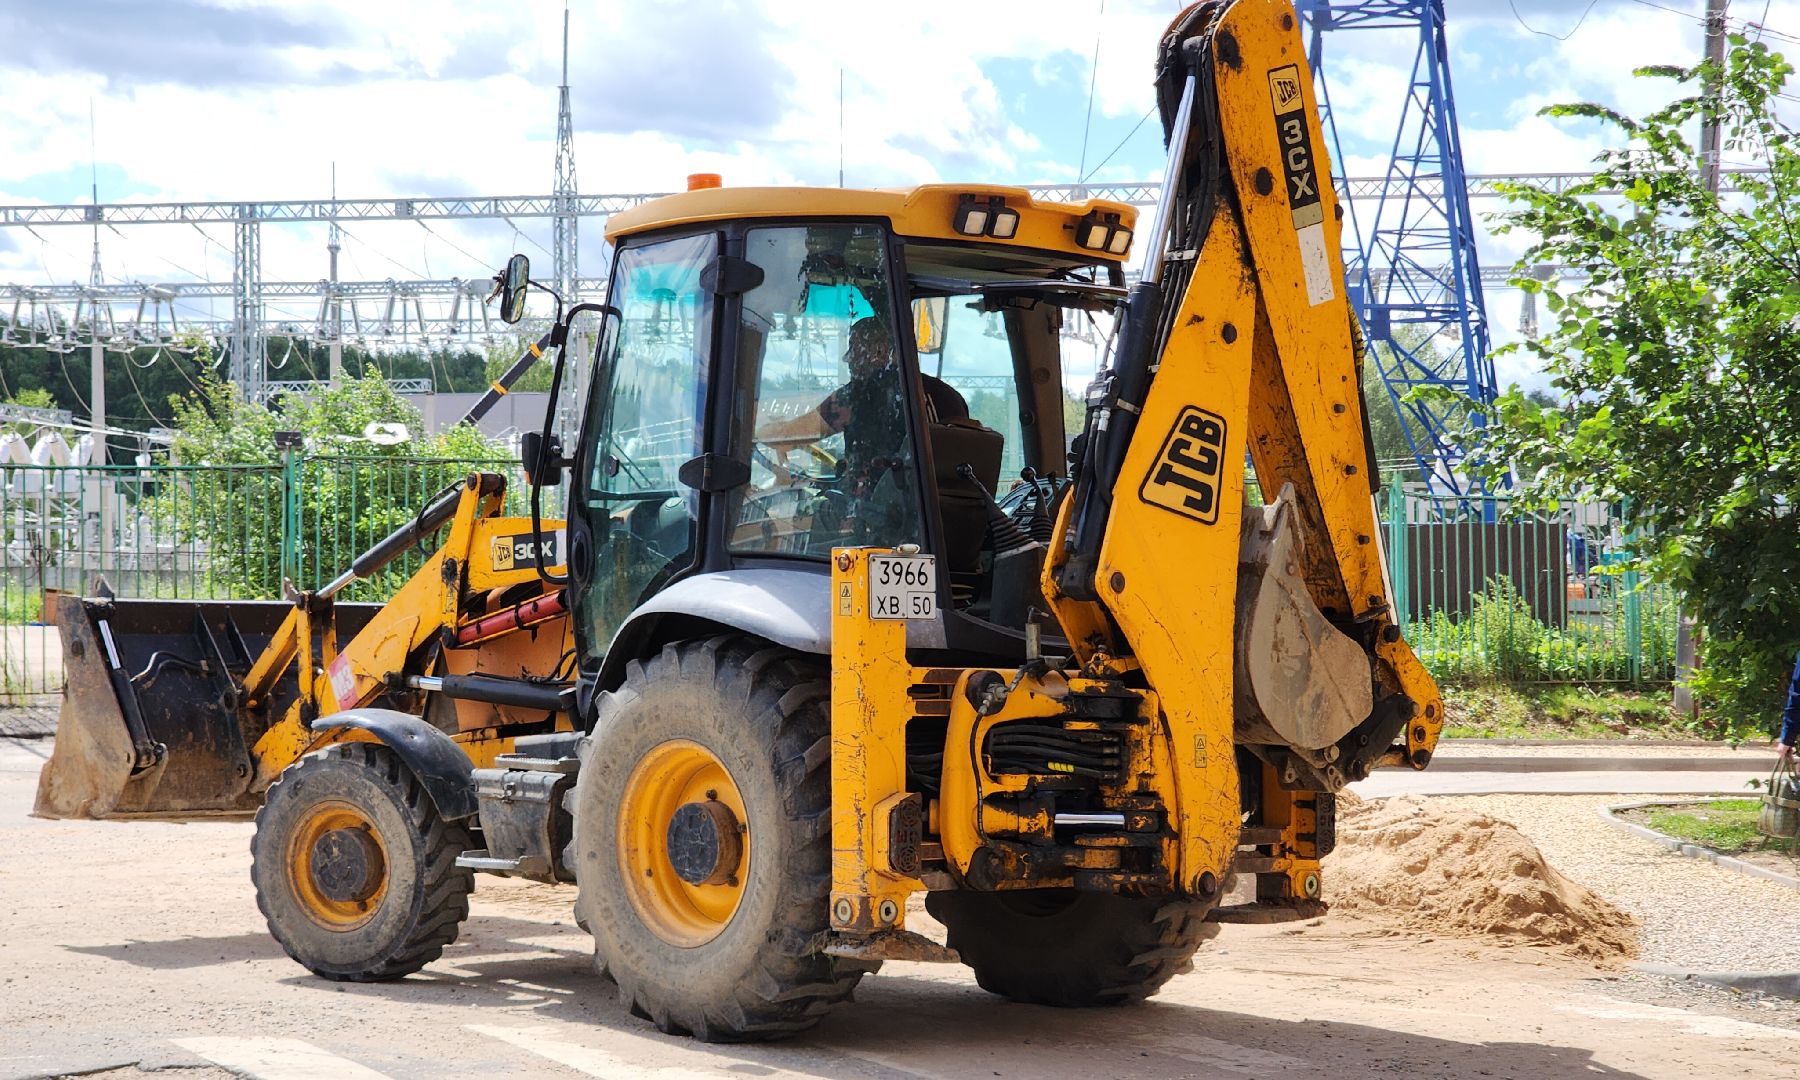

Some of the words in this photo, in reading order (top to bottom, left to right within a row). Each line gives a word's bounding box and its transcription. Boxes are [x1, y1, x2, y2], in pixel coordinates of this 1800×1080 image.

[1277, 79, 1298, 103] JCB
[1283, 118, 1315, 200] 3CX
[1153, 414, 1222, 514] JCB
[497, 545, 511, 562] JCB
[879, 560, 928, 586] 3966
[912, 596, 932, 616] 50
